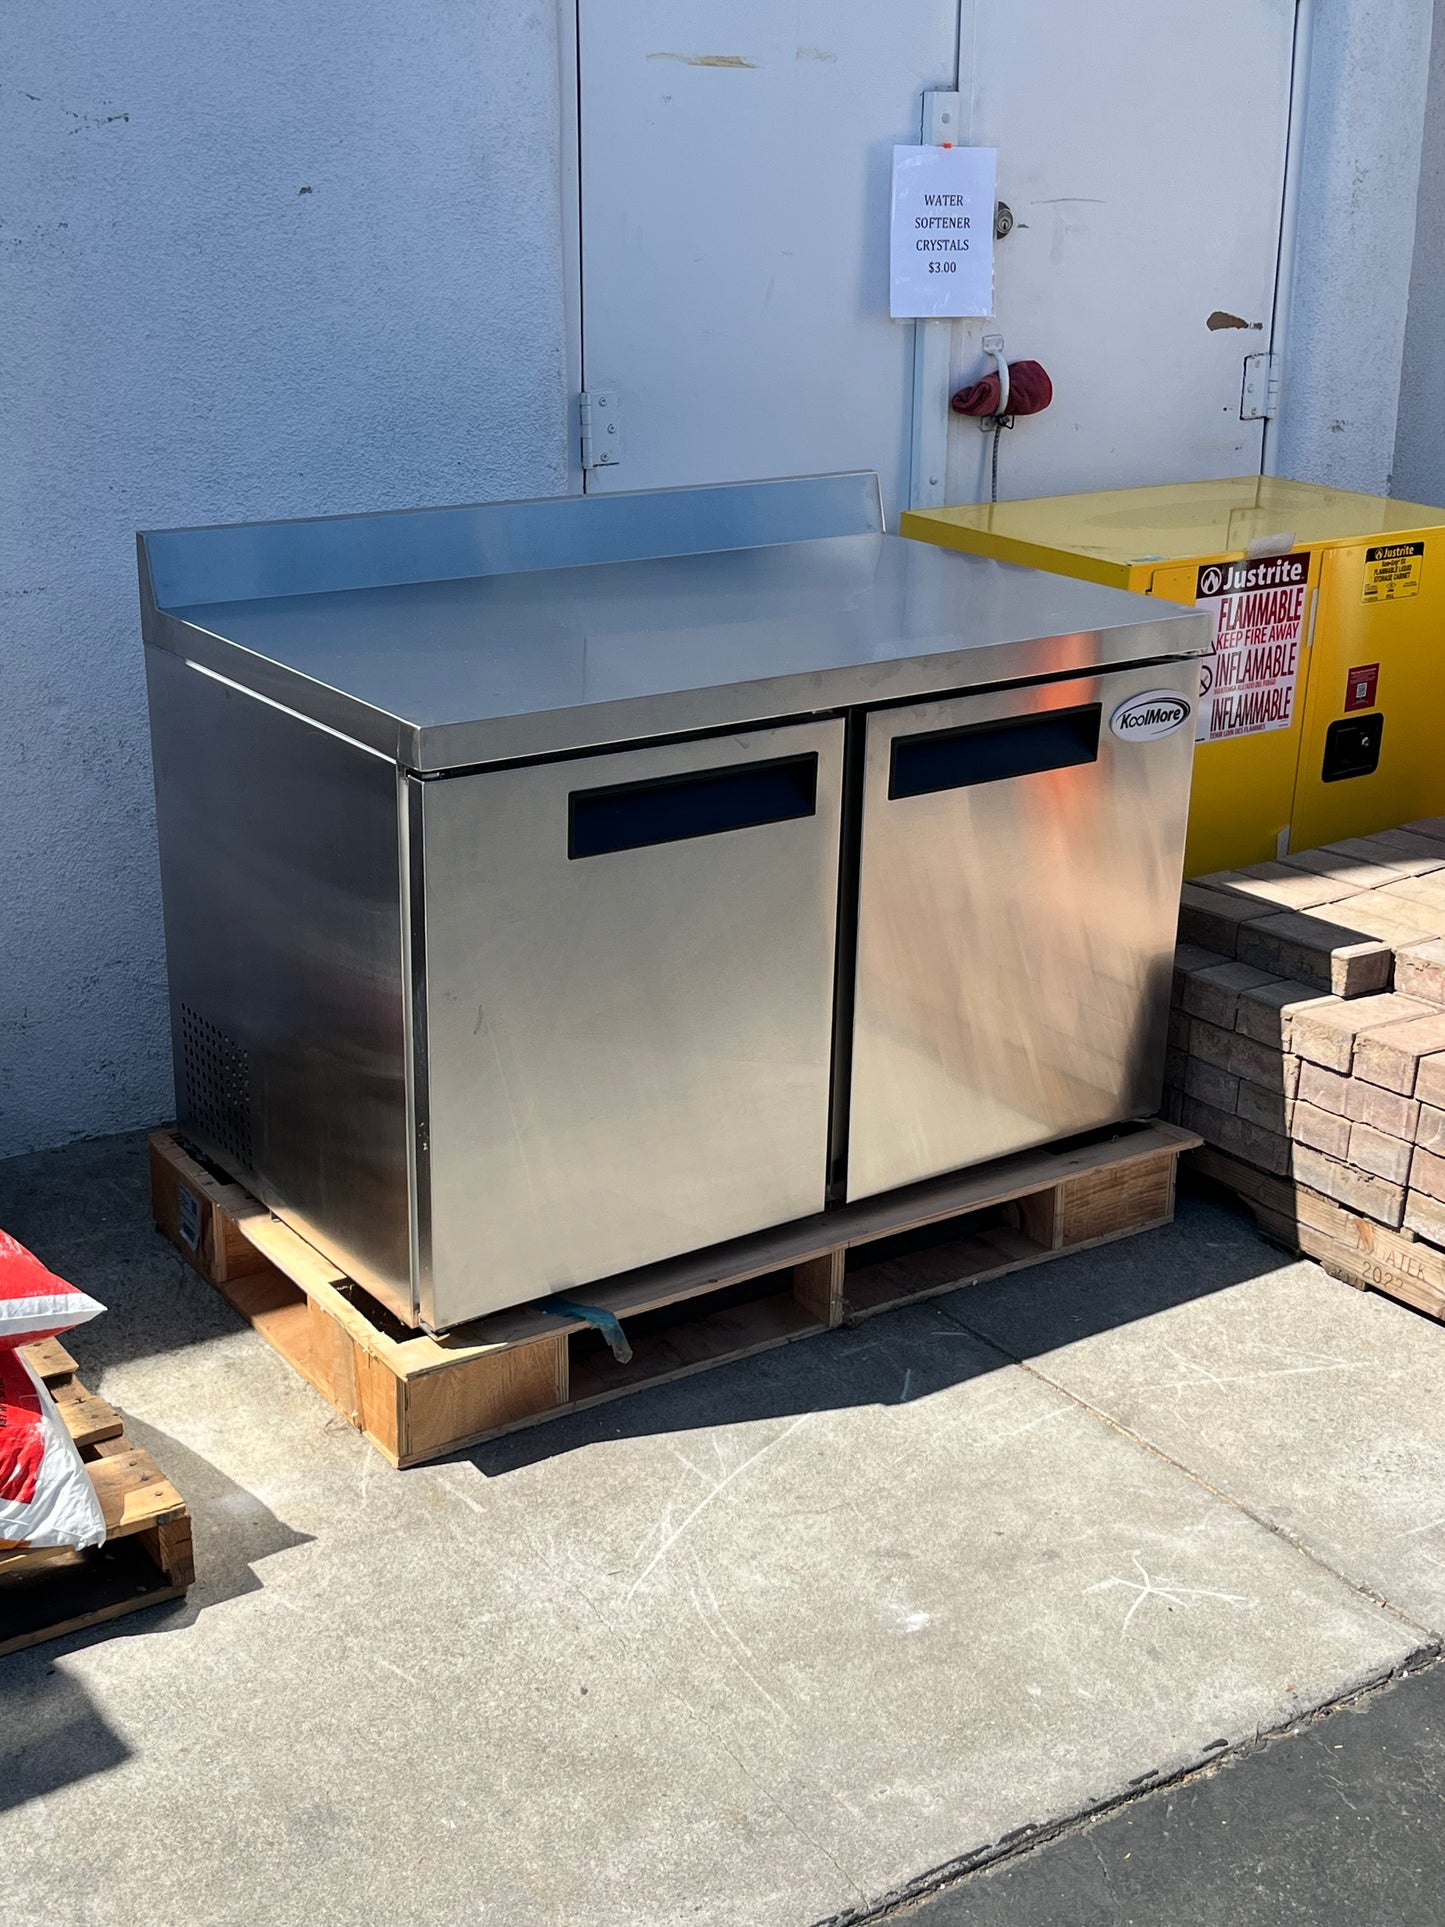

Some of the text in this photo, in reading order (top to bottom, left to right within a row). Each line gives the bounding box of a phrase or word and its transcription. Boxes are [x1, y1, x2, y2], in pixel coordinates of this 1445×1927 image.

[924, 194, 964, 207] WATER
[914, 216, 971, 229] SOFTENER
[916, 239, 970, 251] CRYSTALS
[928, 261, 957, 274] $3.00
[1383, 545, 1414, 558] Justrite
[1223, 559, 1303, 591] Justrite
[1218, 587, 1304, 632] FLAMMABLE
[1216, 621, 1300, 651] KEEP FIRE AWAY
[1215, 642, 1297, 688] INFLAMABLE
[1120, 708, 1181, 730] KoolMore
[1210, 686, 1292, 732] INFLAMMABLE
